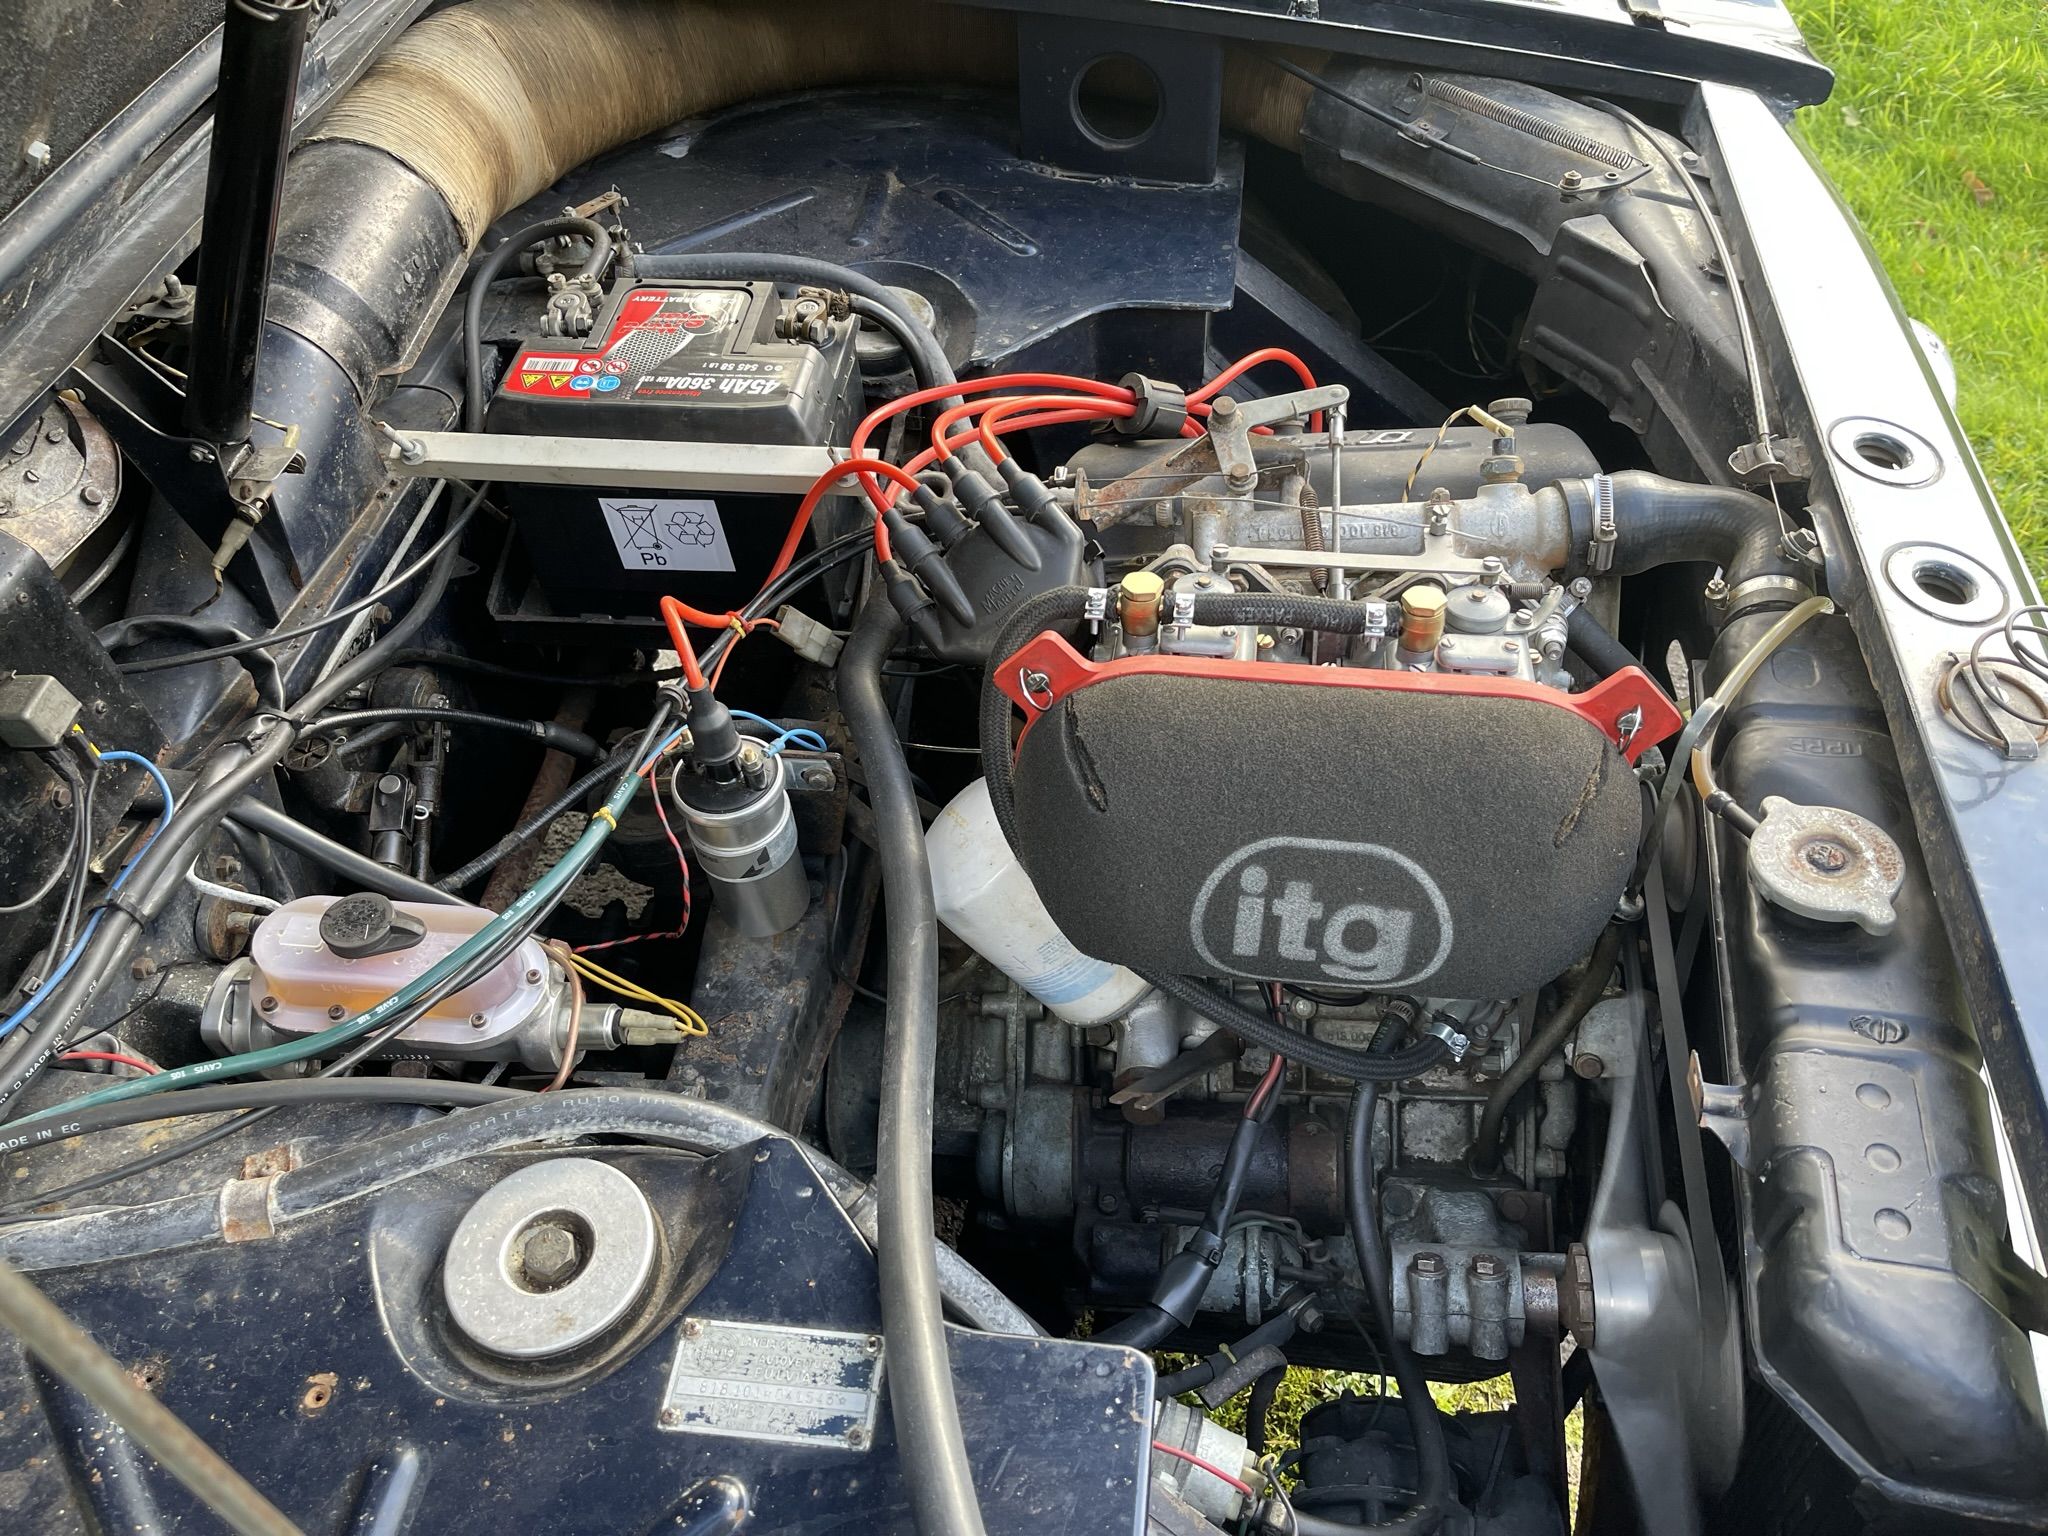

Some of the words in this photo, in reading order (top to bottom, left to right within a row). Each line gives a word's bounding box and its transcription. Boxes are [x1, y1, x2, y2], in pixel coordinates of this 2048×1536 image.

[720, 363, 734, 371] 58
[737, 363, 758, 372] 545
[719, 378, 781, 395] 45Ah
[640, 552, 668, 567] Pb
[613, 782, 629, 800] CAVIS
[1232, 864, 1414, 981] itg
[25, 1049, 51, 1078] MADE
[53, 1034, 63, 1046] IN
[64, 1004, 83, 1031] ITALY
[193, 1061, 222, 1075] CAVIS
[468, 1102, 546, 1132] GATES
[36, 1128, 53, 1140] IN
[61, 1122, 81, 1134] EC
[754, 1366, 811, 1382] FULVIA
